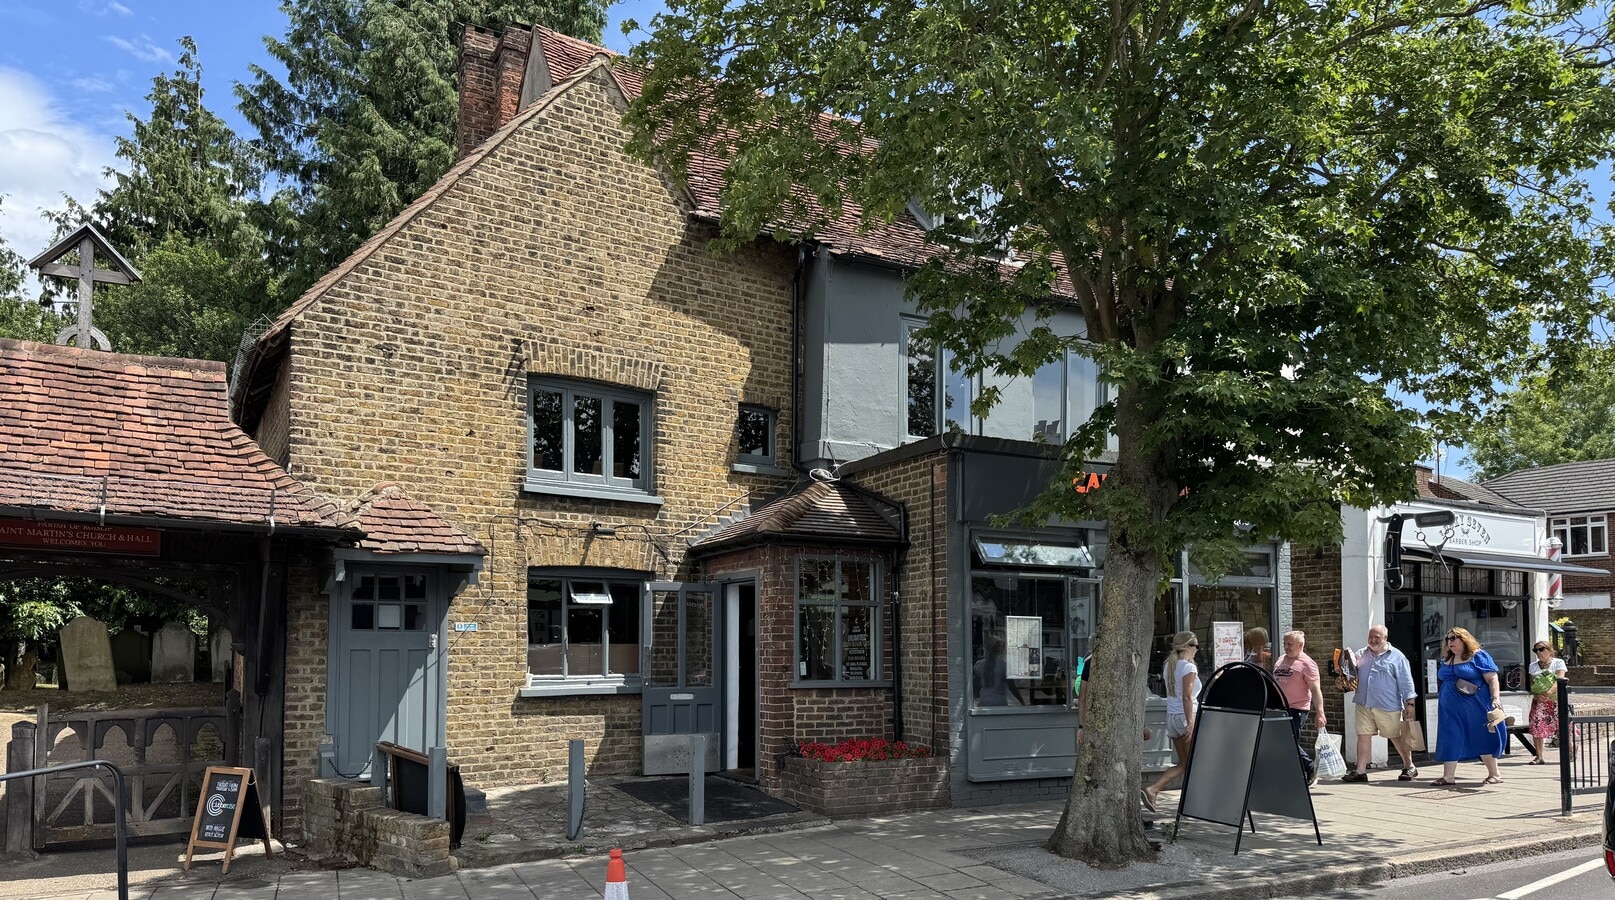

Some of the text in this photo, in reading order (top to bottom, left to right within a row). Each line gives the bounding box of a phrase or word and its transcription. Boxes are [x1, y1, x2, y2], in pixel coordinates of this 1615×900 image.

[26, 528, 75, 538] MARTIN'S
[76, 531, 117, 541] CHURCH
[118, 534, 126, 542] &
[127, 534, 153, 543] HALL
[1466, 515, 1491, 545] SEVEN
[42, 537, 106, 548] WELCOMES YOU
